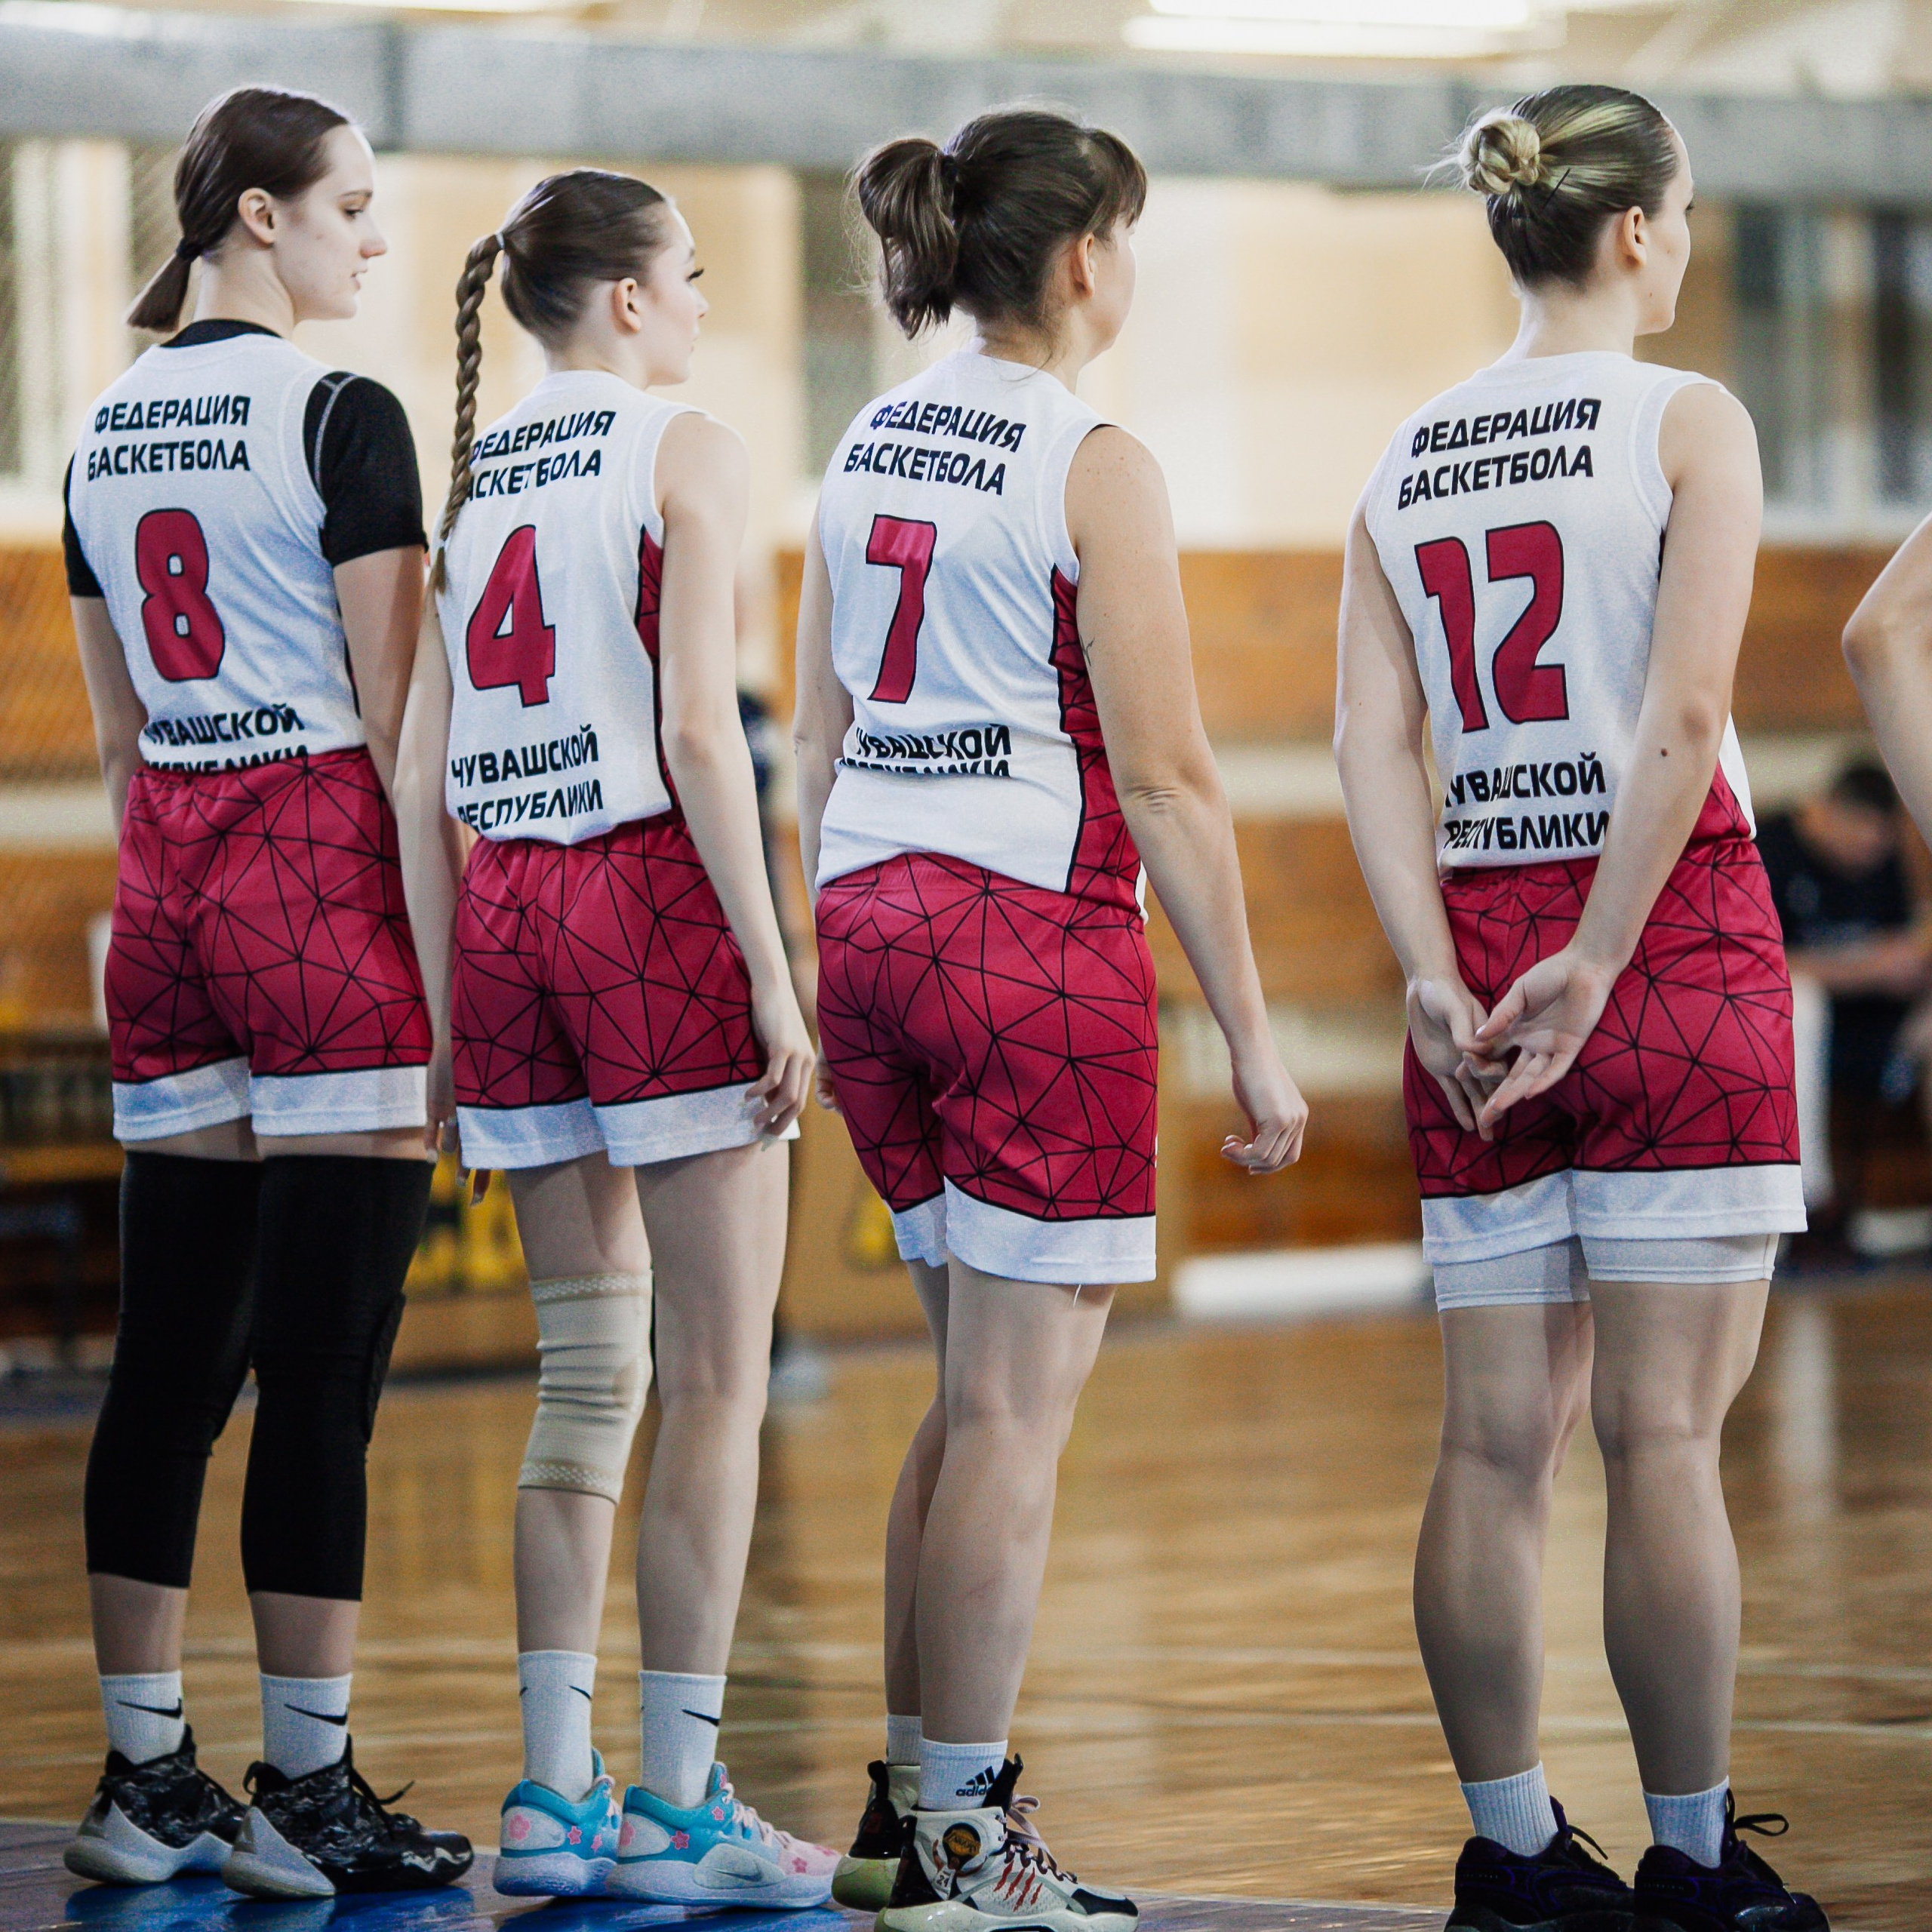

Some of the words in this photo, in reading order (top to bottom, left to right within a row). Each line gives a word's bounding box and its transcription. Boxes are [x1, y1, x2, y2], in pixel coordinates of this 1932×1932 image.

[94, 395, 251, 434] ФЕДЕРАЦИЯ
[869, 401, 1026, 453] ФЕДЕРАЦИЯ
[1411, 398, 1601, 458] ФЕДЕРАЦИЯ
[88, 439, 251, 481] БАСКЕТБОЛА
[843, 442, 1006, 496] БАСКЕТБОЛА
[1398, 445, 1594, 510] БАСКЕТБОЛА
[135, 507, 225, 683] 8
[466, 524, 555, 708] 4
[866, 513, 937, 704] 7
[1414, 519, 1570, 734] 12
[451, 723, 599, 788] ЧУВАШСКОЙ
[1445, 751, 1607, 808] УВАШСКОЙ
[955, 1785, 987, 1796] adid
